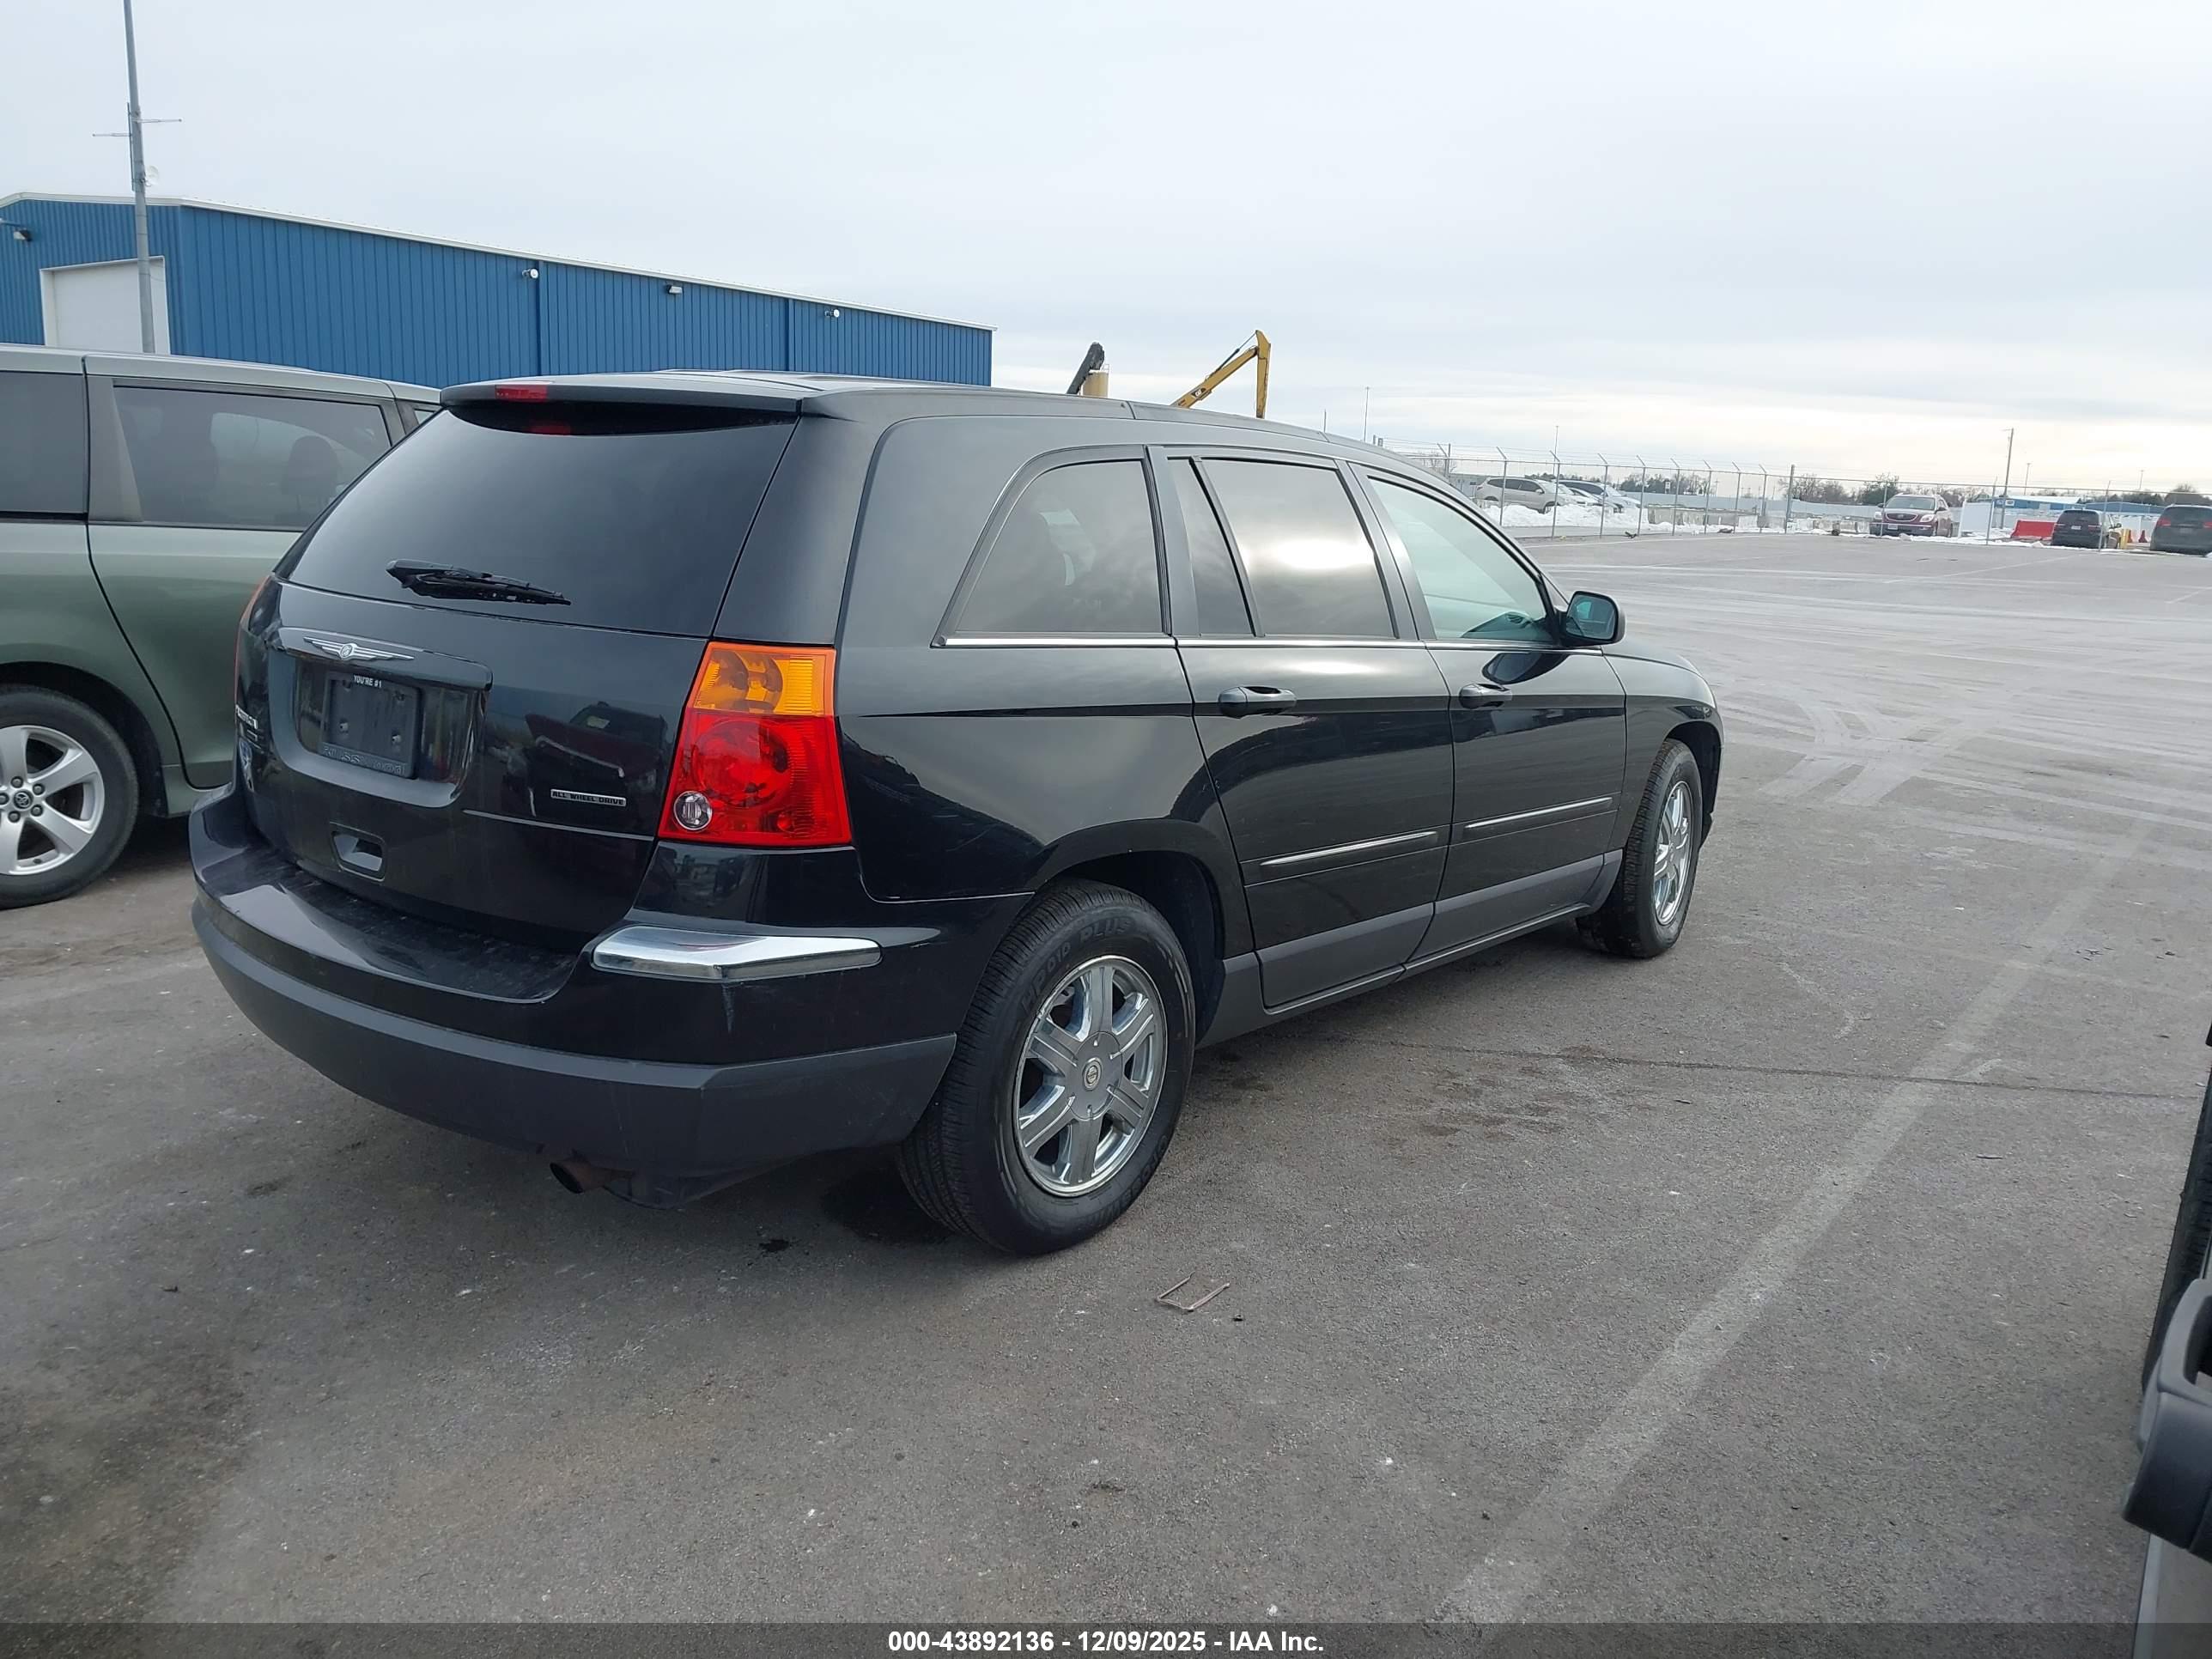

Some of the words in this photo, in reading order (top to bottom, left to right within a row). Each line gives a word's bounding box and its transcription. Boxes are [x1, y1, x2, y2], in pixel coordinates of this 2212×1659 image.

[353, 674, 374, 686] YOU'RE
[569, 793, 598, 803] WHEEL
[599, 797, 625, 805] DRIVE
